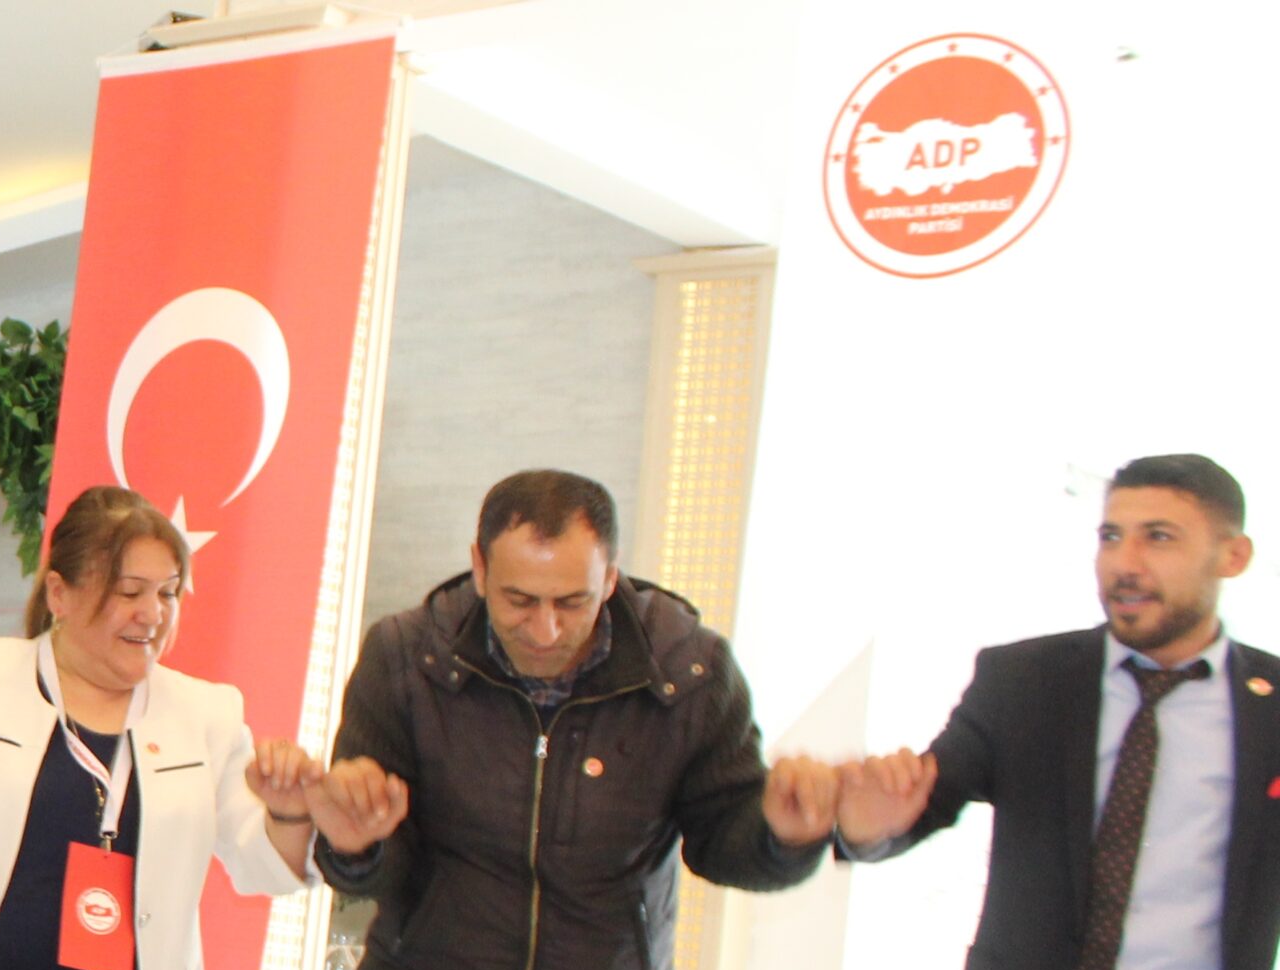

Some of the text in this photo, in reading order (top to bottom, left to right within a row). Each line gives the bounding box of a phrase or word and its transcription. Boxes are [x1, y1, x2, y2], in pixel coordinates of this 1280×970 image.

[905, 138, 981, 171] ADP
[864, 197, 1014, 220] AYDINLIK DEMOKRASİ
[908, 217, 963, 234] PARTİSİ
